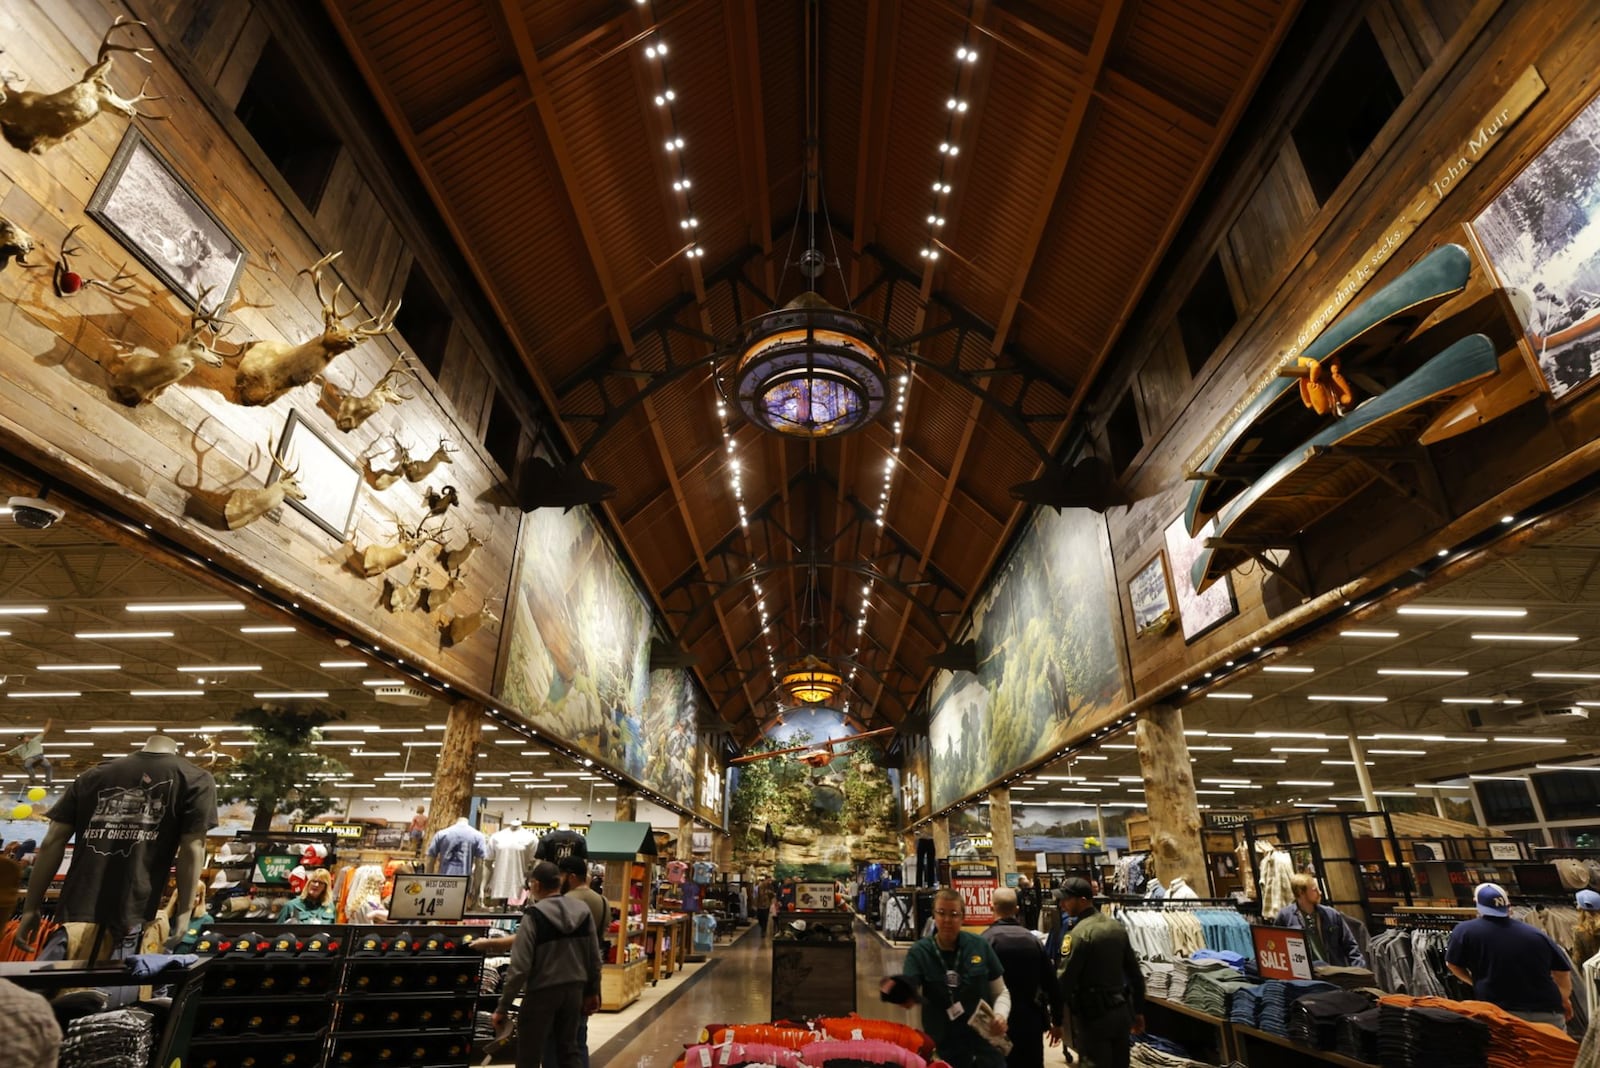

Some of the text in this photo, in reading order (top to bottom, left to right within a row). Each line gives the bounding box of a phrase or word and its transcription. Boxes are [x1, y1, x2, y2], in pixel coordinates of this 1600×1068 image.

[1256, 377, 1270, 393] one
[1297, 334, 1309, 347] far
[1310, 304, 1334, 332] more
[1334, 280, 1357, 306] than
[1355, 264, 1371, 281] he
[1433, 156, 1468, 199] John
[1468, 108, 1509, 155] Muir
[1212, 815, 1249, 823] FITTING
[425, 880, 458, 889] WEST CHESTER
[435, 887, 445, 896] HAT
[1260, 950, 1289, 971] SALE
